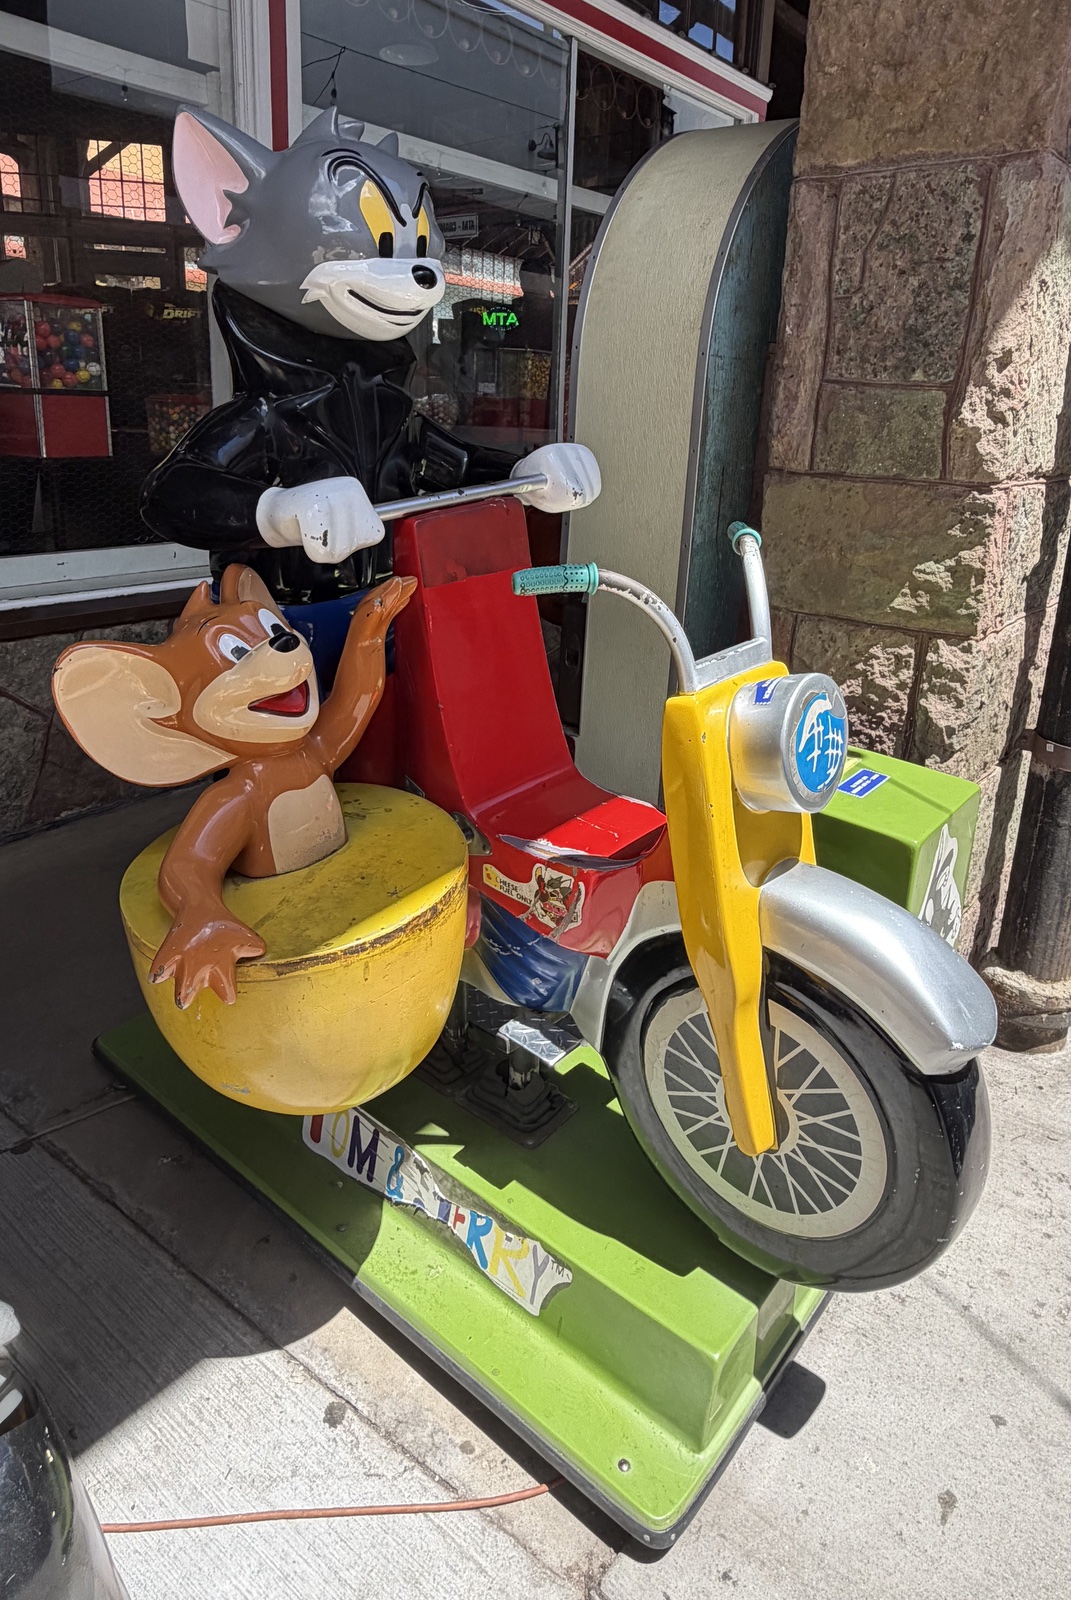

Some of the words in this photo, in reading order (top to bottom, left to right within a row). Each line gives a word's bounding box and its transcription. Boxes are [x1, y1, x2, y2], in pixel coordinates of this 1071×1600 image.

[496, 876, 518, 892] CHEESE
[500, 885, 513, 897] FUEL
[516, 893, 533, 904] ONLY
